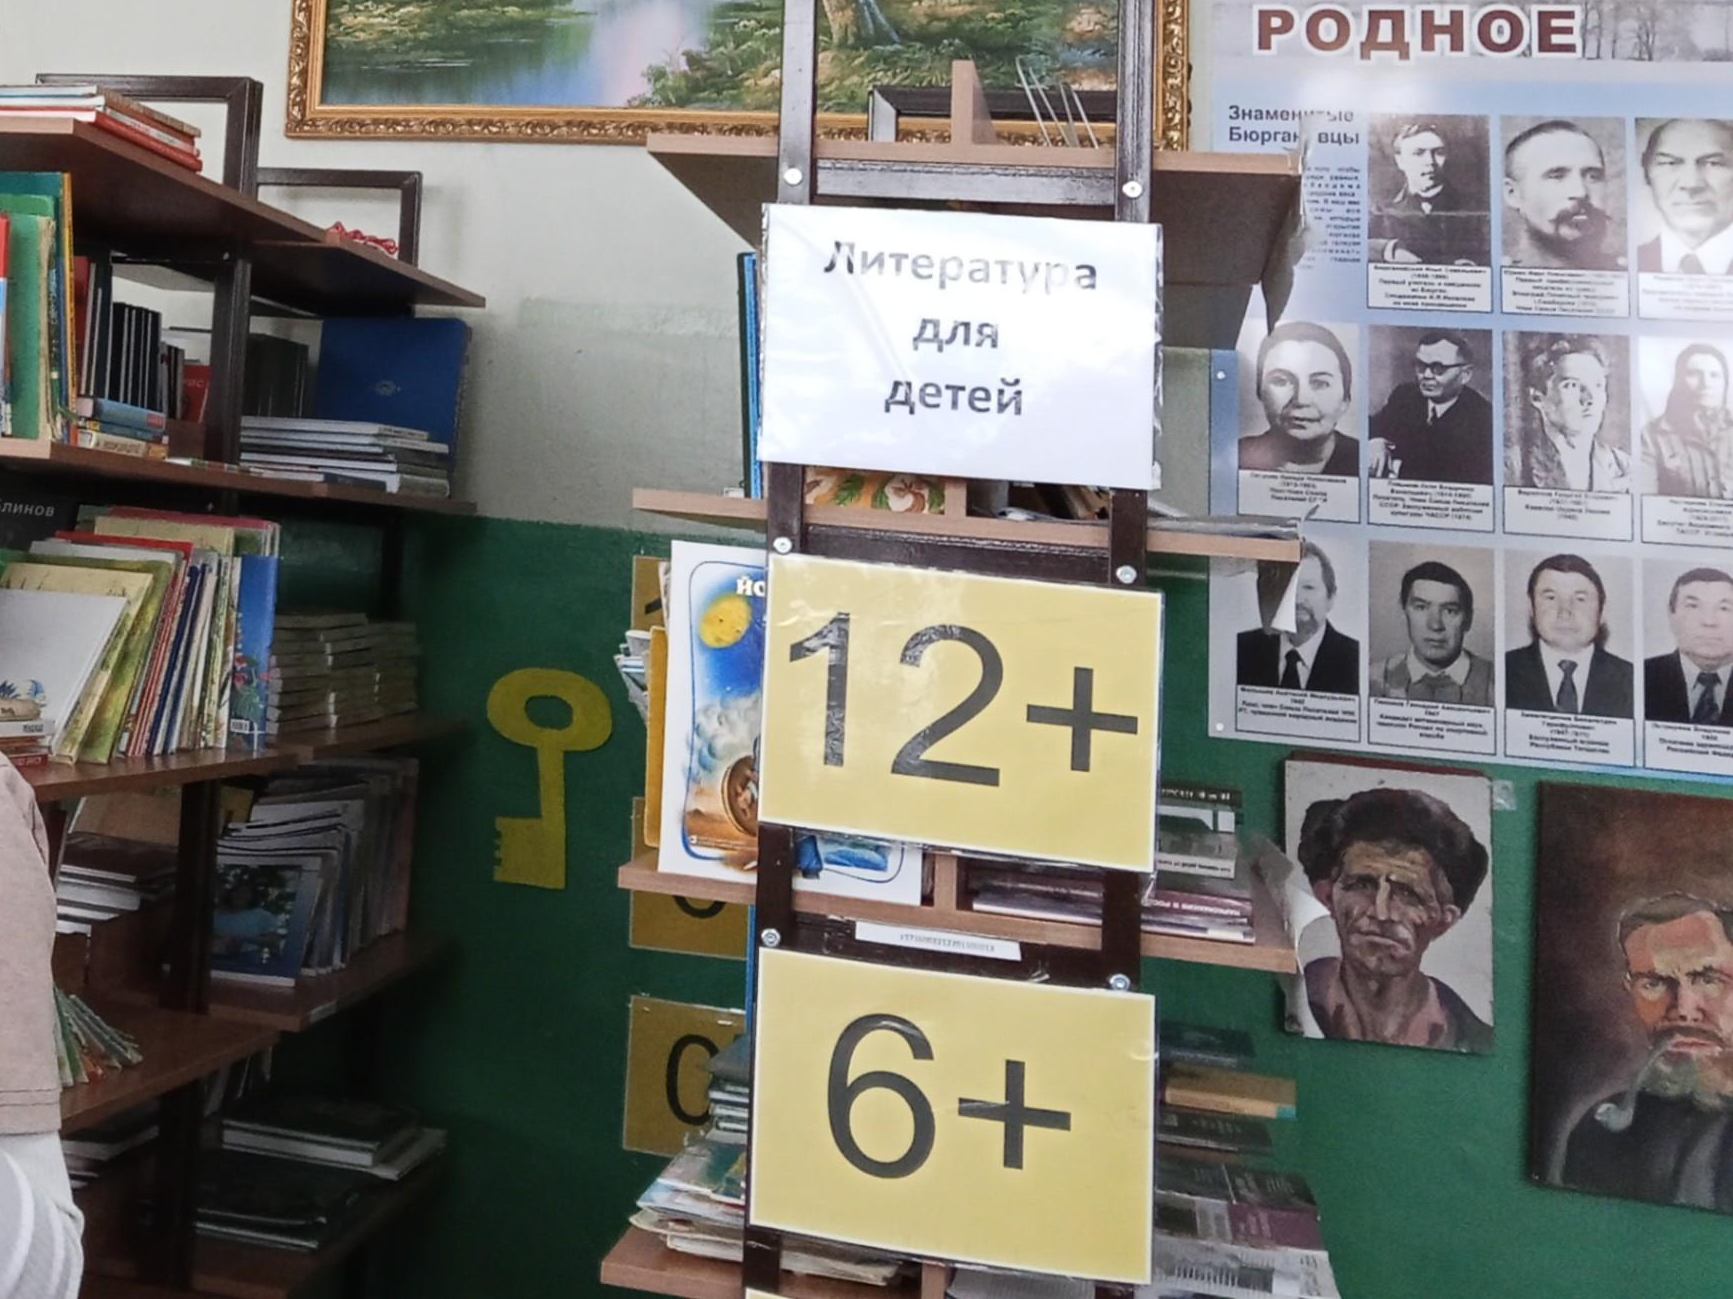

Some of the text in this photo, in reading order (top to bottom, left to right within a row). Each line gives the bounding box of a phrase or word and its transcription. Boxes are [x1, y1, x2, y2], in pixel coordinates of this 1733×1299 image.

[1257, 8, 1578, 61] РОДНОЕ
[1228, 104, 1355, 123] Знаменые
[1228, 126, 1360, 146] Бюрганвцы
[822, 238, 1099, 298] Литература
[911, 316, 1001, 352] для
[883, 377, 1024, 418] детей
[787, 610, 1139, 789] 12+
[825, 1011, 1072, 1180] 6+
